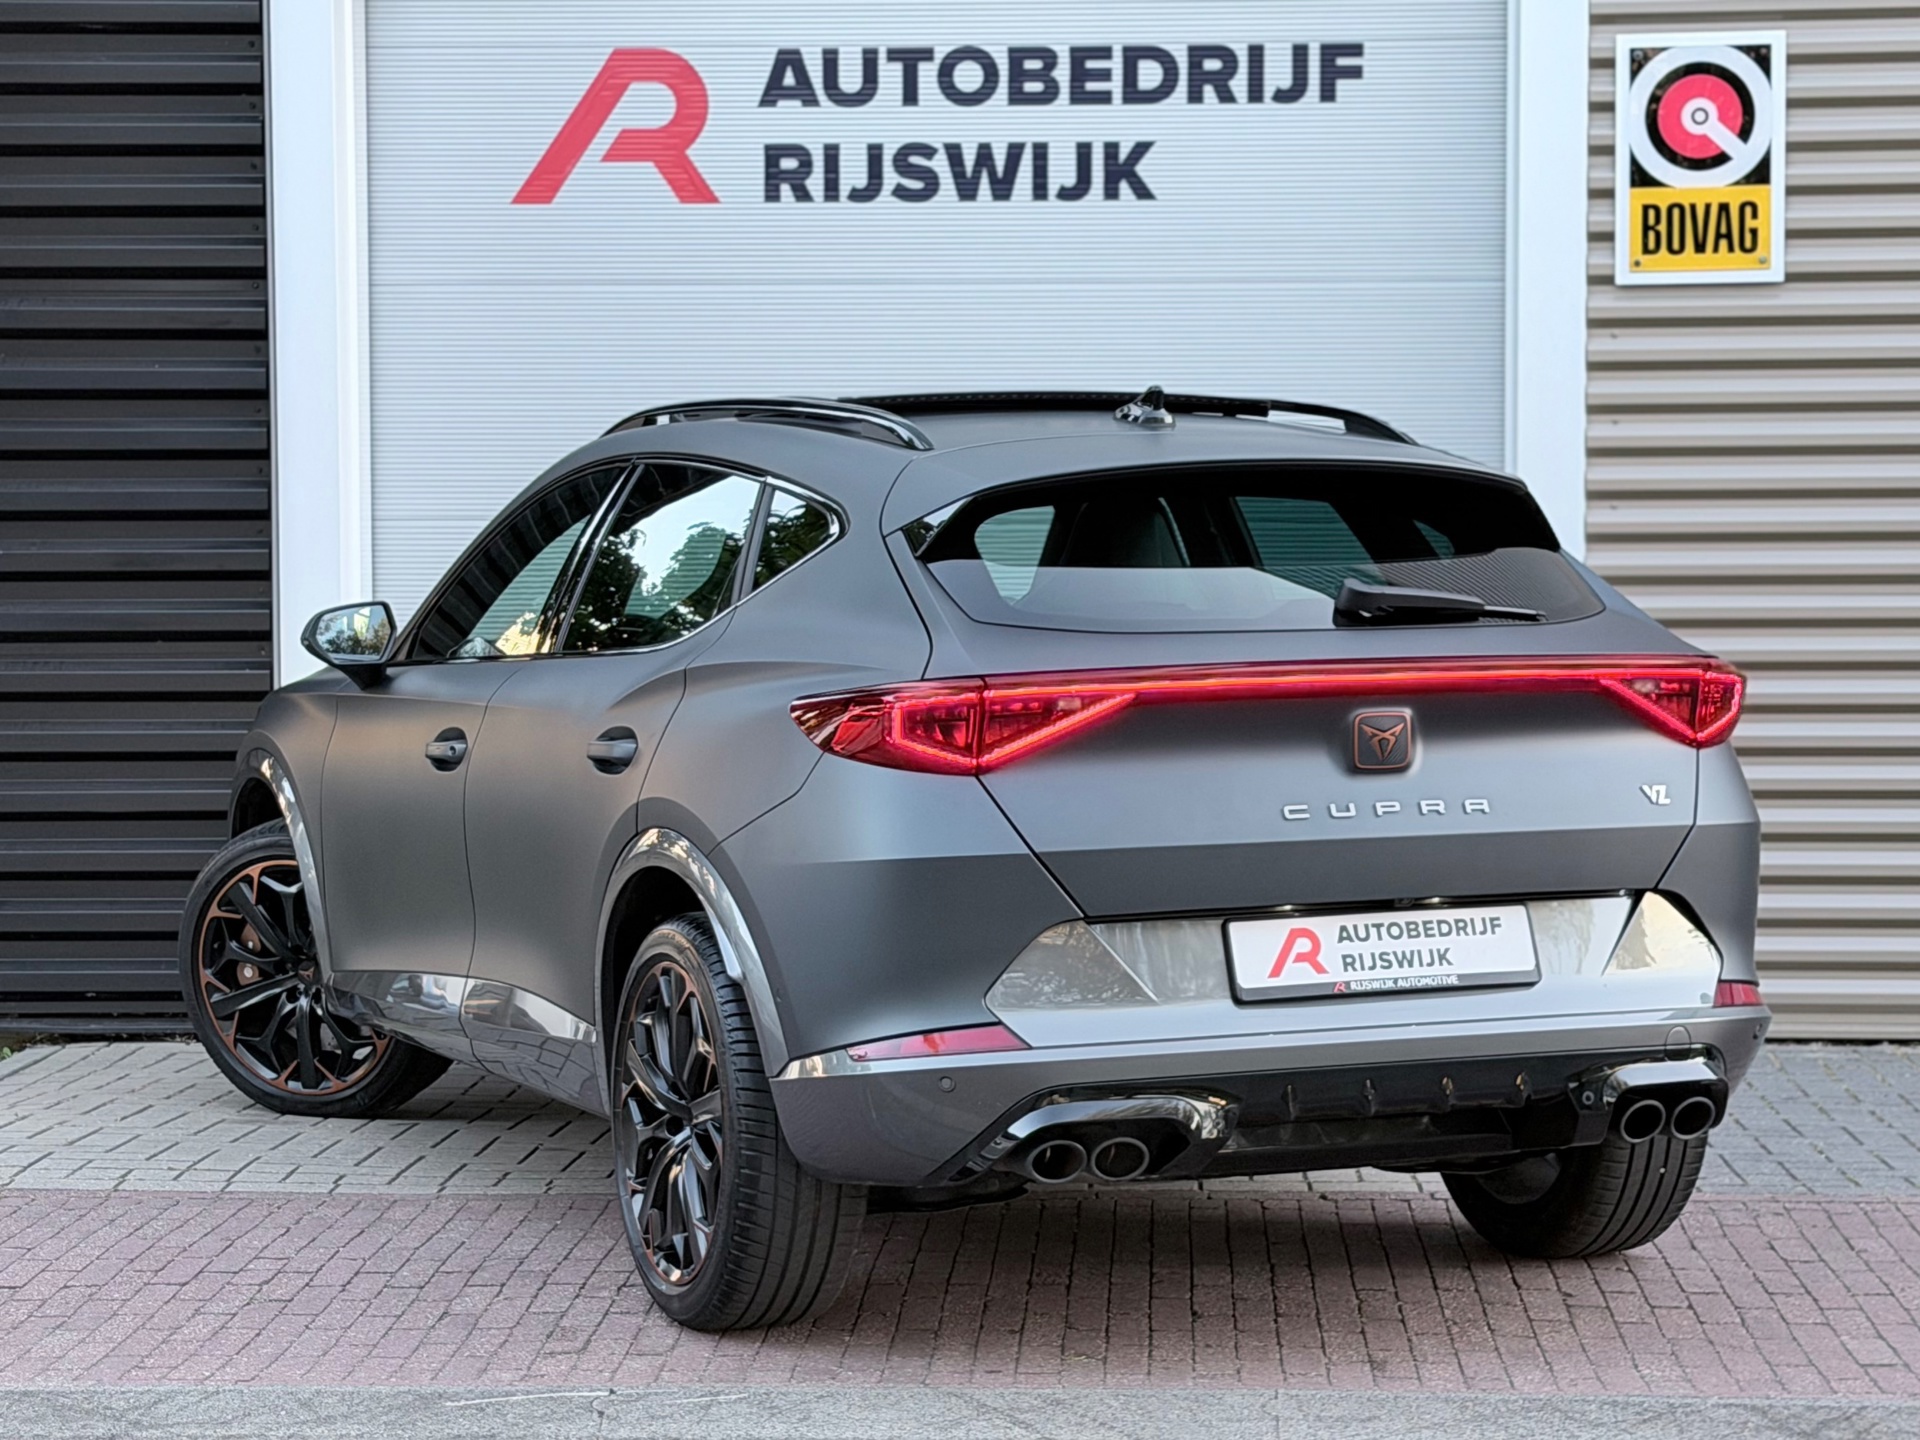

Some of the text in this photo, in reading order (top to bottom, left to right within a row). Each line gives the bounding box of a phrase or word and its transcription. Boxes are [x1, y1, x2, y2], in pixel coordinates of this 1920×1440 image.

[758, 43, 1364, 107] AUTOBEDRIJF
[763, 141, 1156, 202] RIJSWIJK
[1641, 200, 1759, 256] BOVAG
[1639, 784, 1671, 805] VZ
[1282, 798, 1490, 821] CUPRA
[1337, 916, 1502, 944] AUTOBEDRIJF
[1341, 947, 1453, 973] RIJSWIJK
[1350, 979, 1395, 990] RIJSWIJK
[1397, 975, 1459, 988] AUTOMOTIVE
